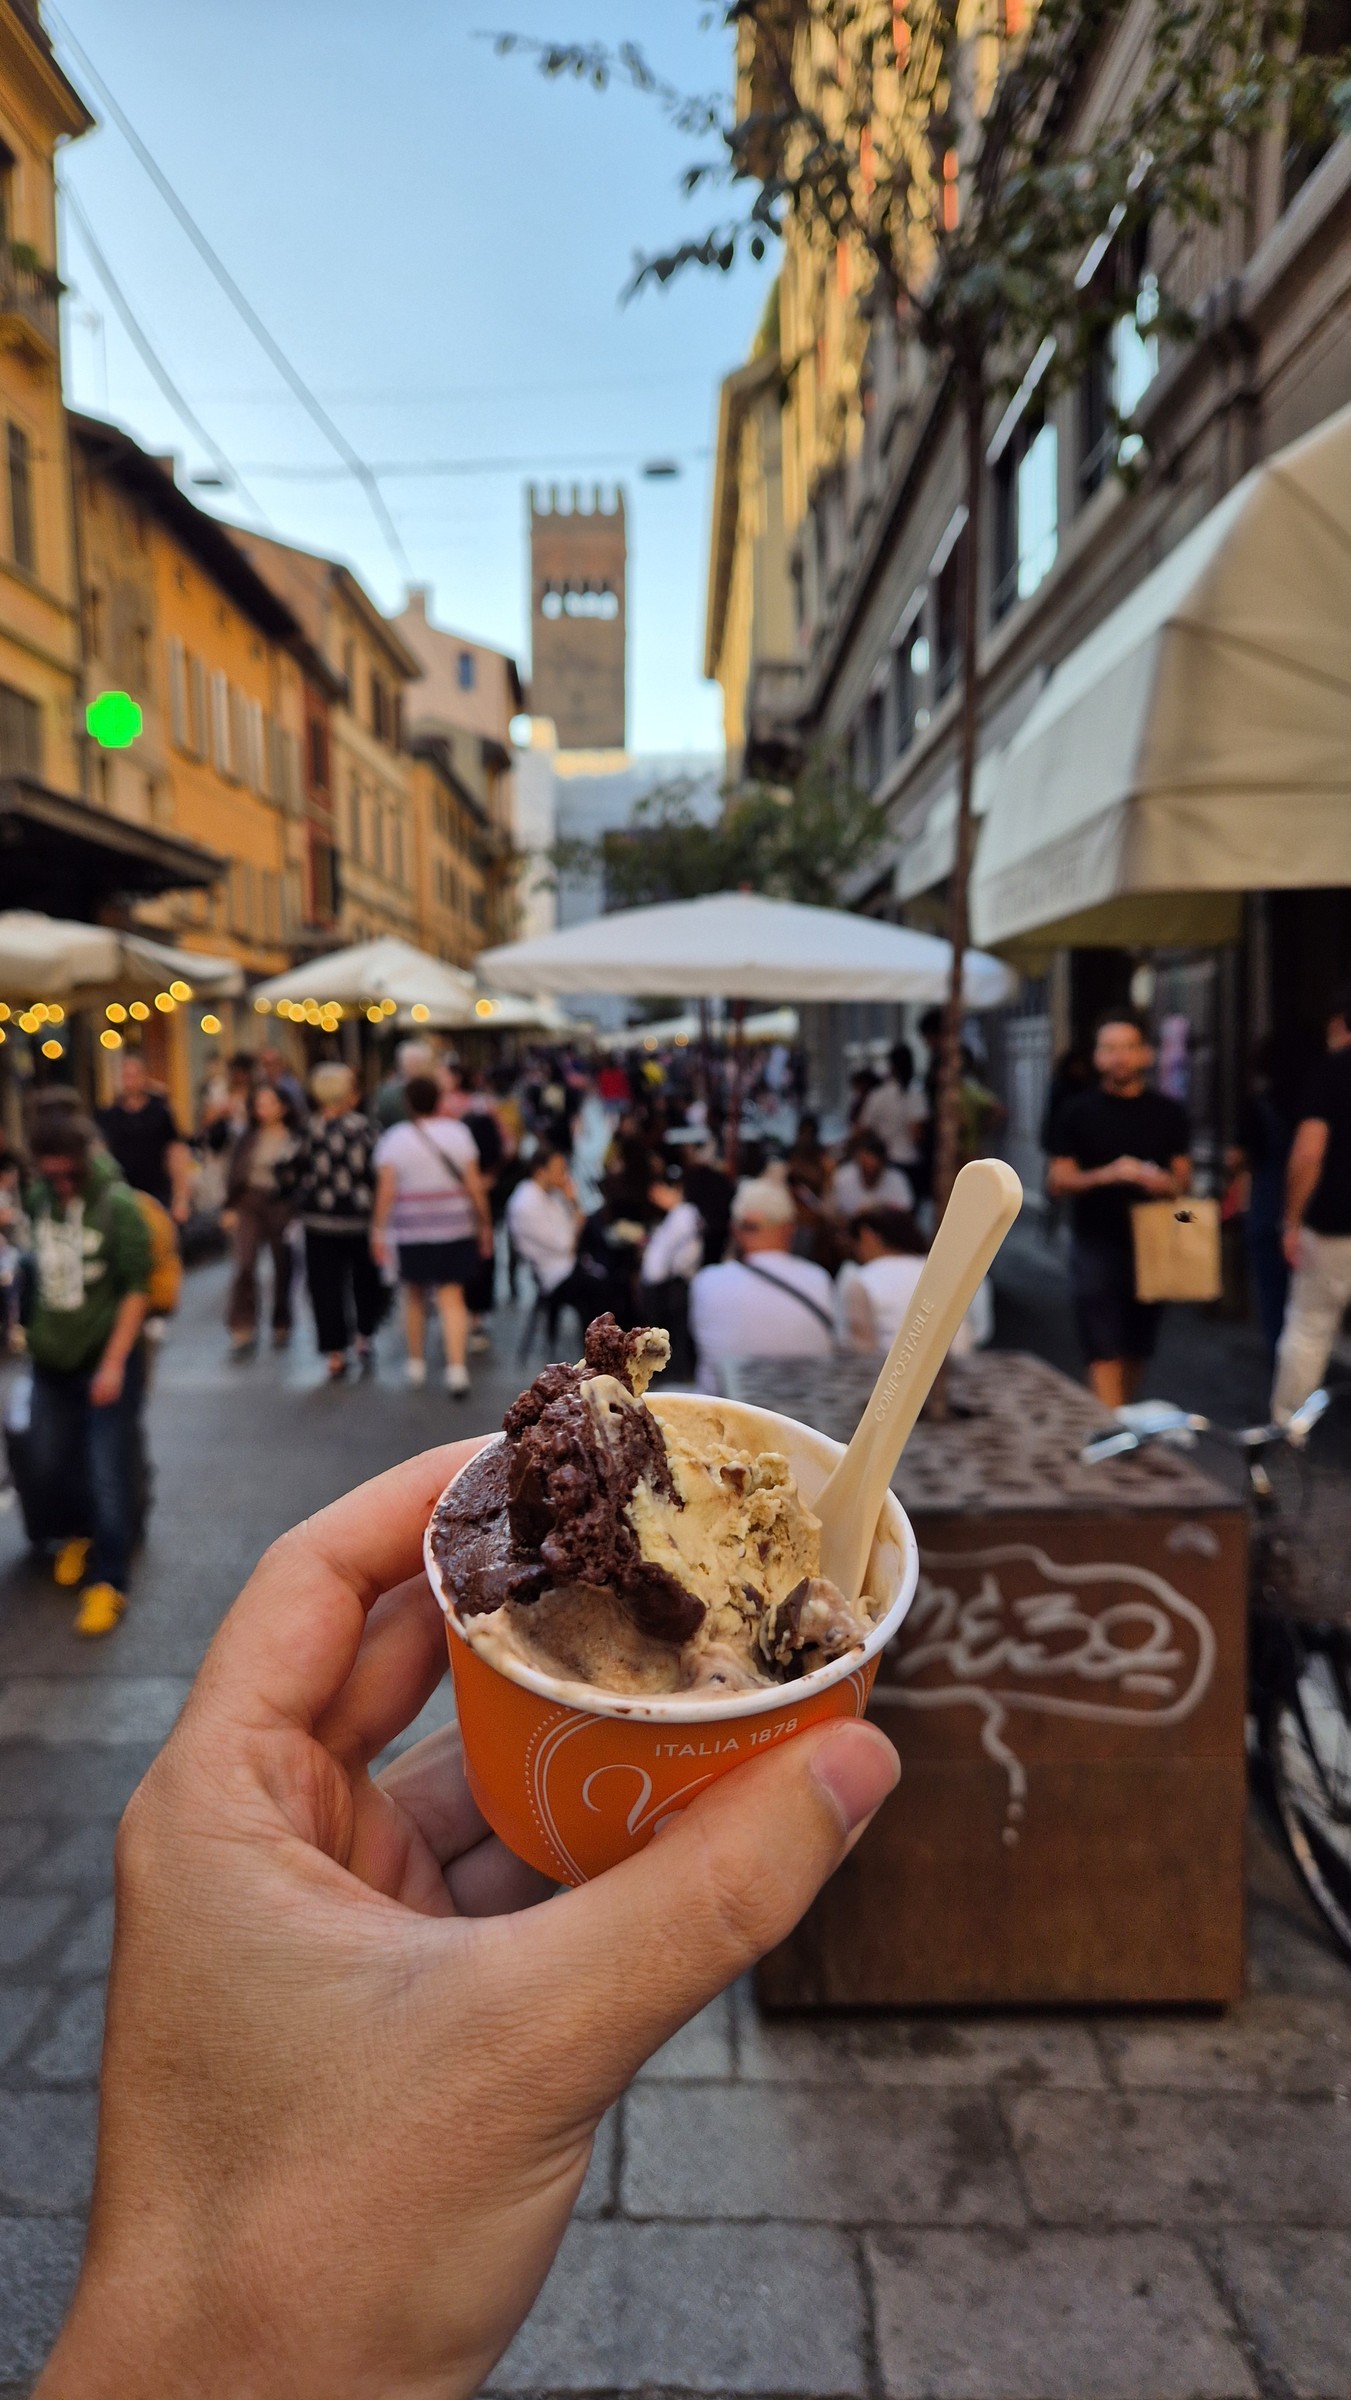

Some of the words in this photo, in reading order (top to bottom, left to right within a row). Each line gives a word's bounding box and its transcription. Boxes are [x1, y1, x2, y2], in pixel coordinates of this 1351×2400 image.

[874, 1298, 935, 1424] COMPOSTABLE
[656, 1738, 739, 1758] ITALIA
[750, 1718, 798, 1746] 1878
[582, 1763, 714, 1836] V
